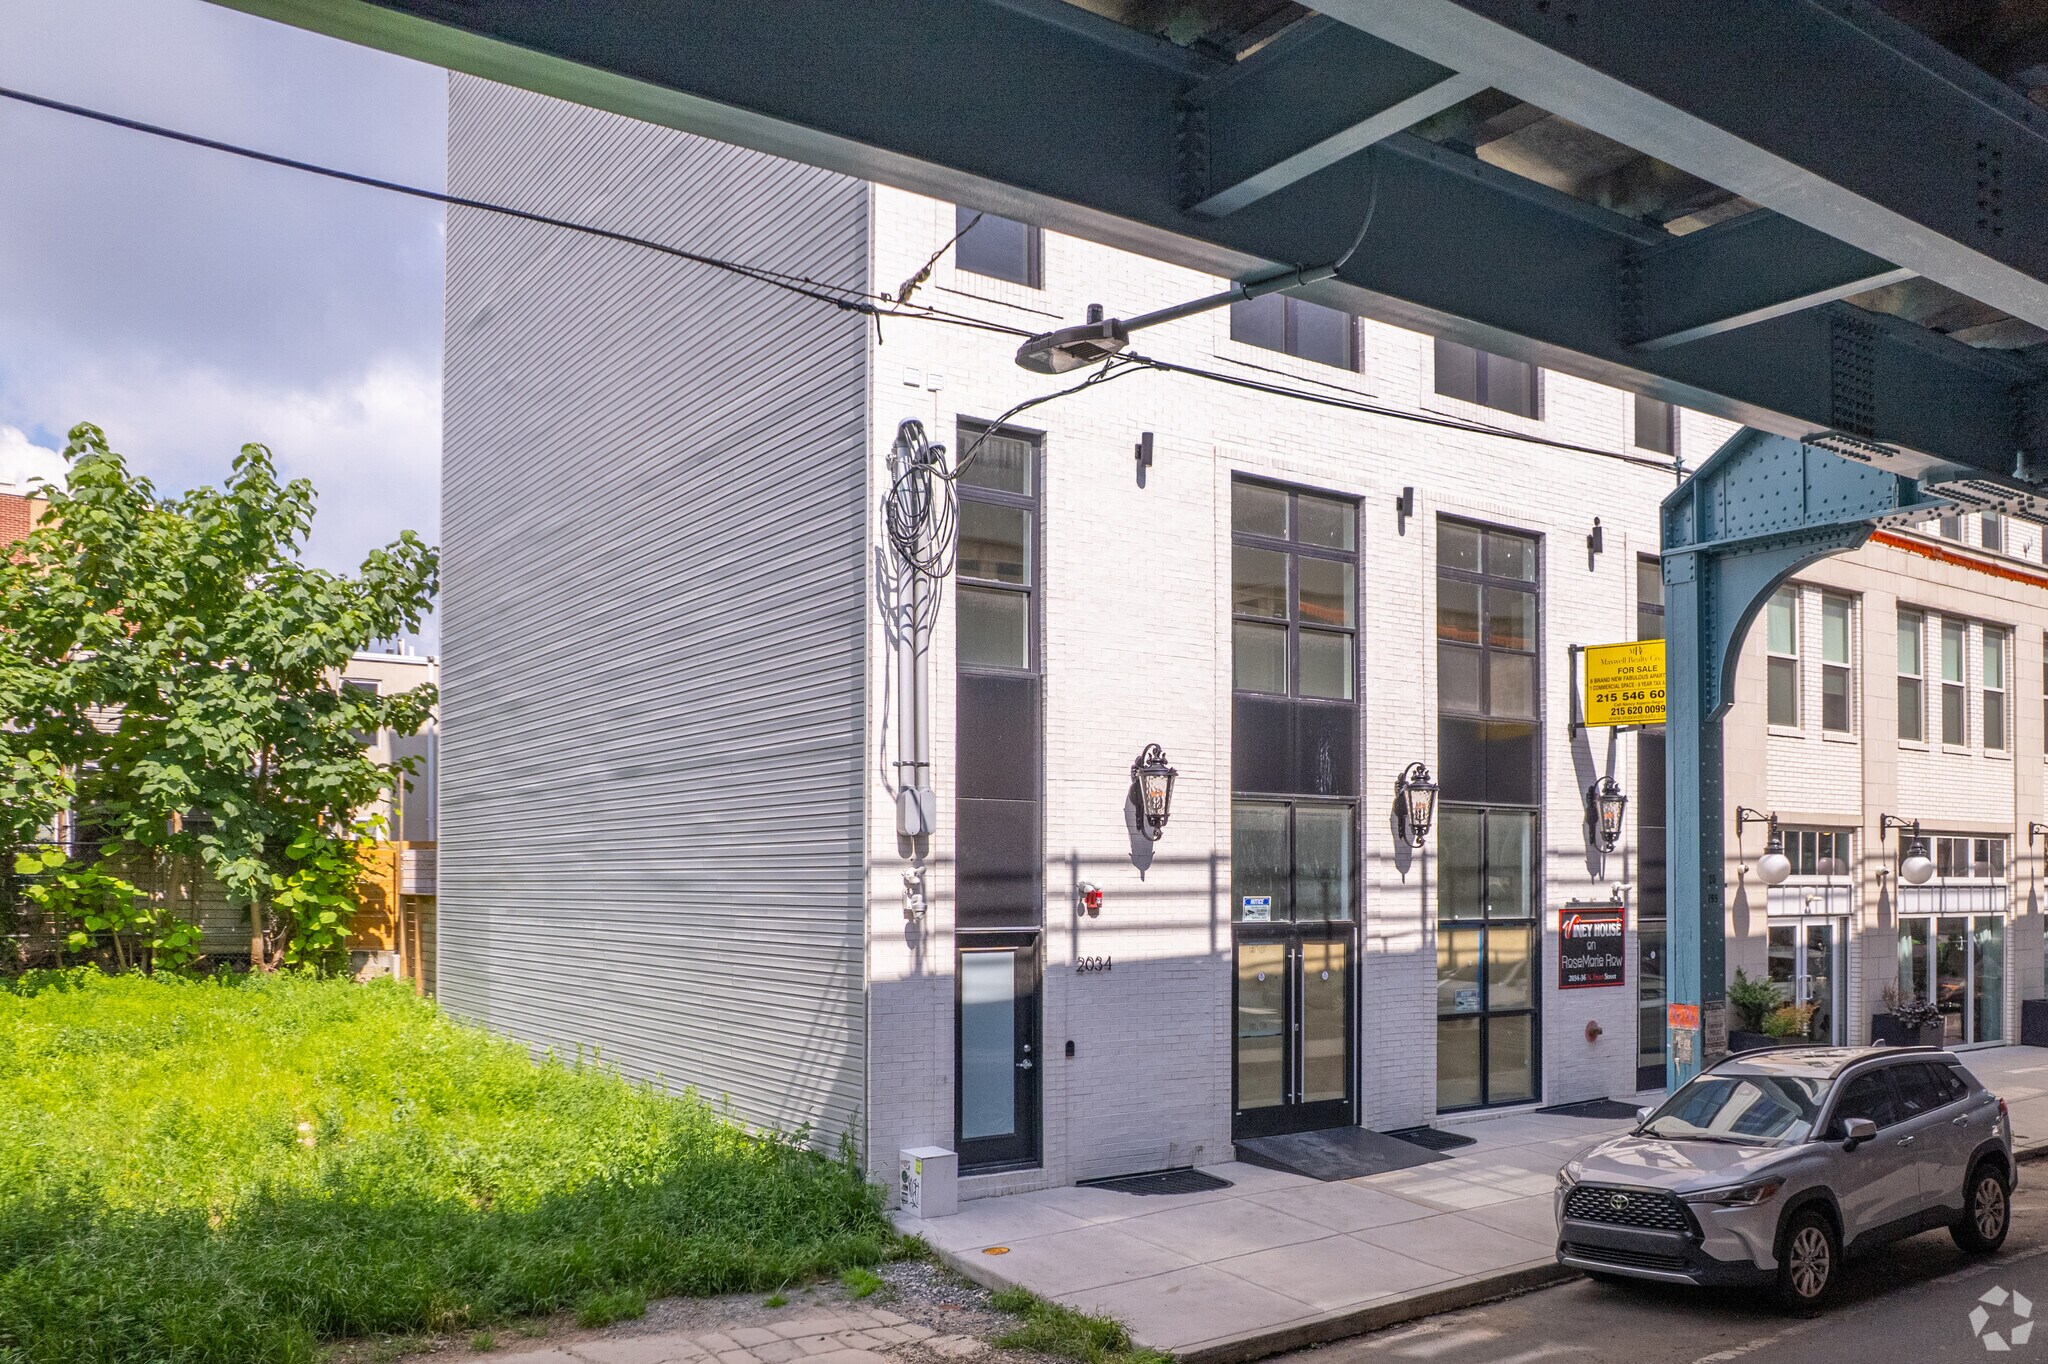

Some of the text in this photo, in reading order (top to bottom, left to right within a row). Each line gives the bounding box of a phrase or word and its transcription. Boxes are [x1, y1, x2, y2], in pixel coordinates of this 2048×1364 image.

[1617, 665, 1658, 675] FOR SALE
[1594, 676, 1611, 684] BRAND
[1596, 689, 1665, 703] 215 546 60
[1611, 704, 1666, 716] 215 620 0099
[1594, 922, 1622, 937] HOUSE
[1586, 941, 1597, 950] on
[1076, 955, 1112, 972] 2034
[1562, 953, 1623, 969] RoseMarie Row
[1568, 974, 1586, 982] 2034-36
[1604, 972, 1617, 980] Street
